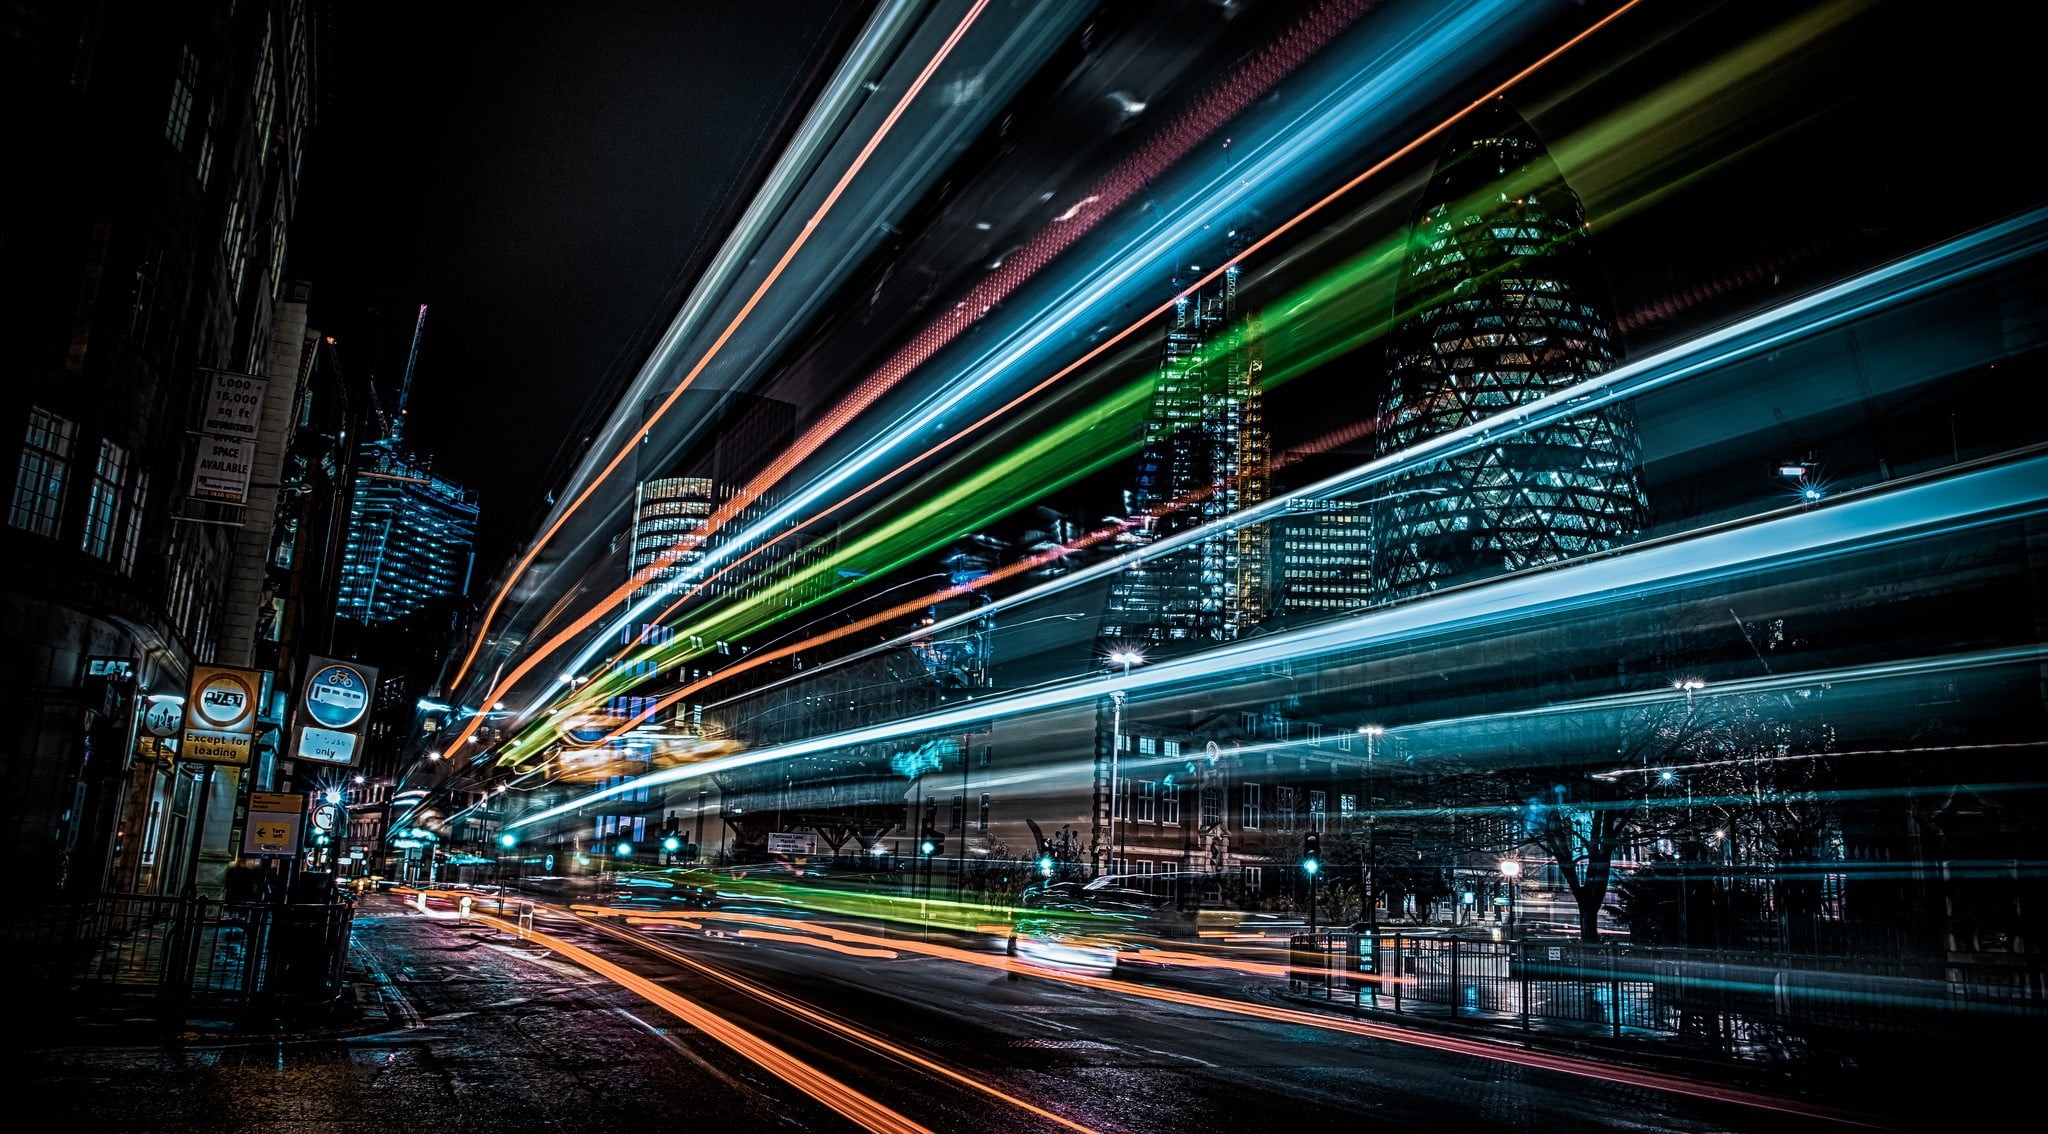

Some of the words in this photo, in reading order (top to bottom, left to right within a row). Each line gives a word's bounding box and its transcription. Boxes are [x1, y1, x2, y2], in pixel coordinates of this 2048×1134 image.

[217, 377, 251, 390] 1,000
[218, 407, 233, 417] sq
[239, 407, 251, 419] ft
[212, 446, 240, 459] SPACE
[200, 459, 249, 475] AVAILABLE
[186, 733, 226, 746] Except
[231, 736, 249, 747] for
[194, 746, 237, 759] loading
[315, 748, 336, 759] only
